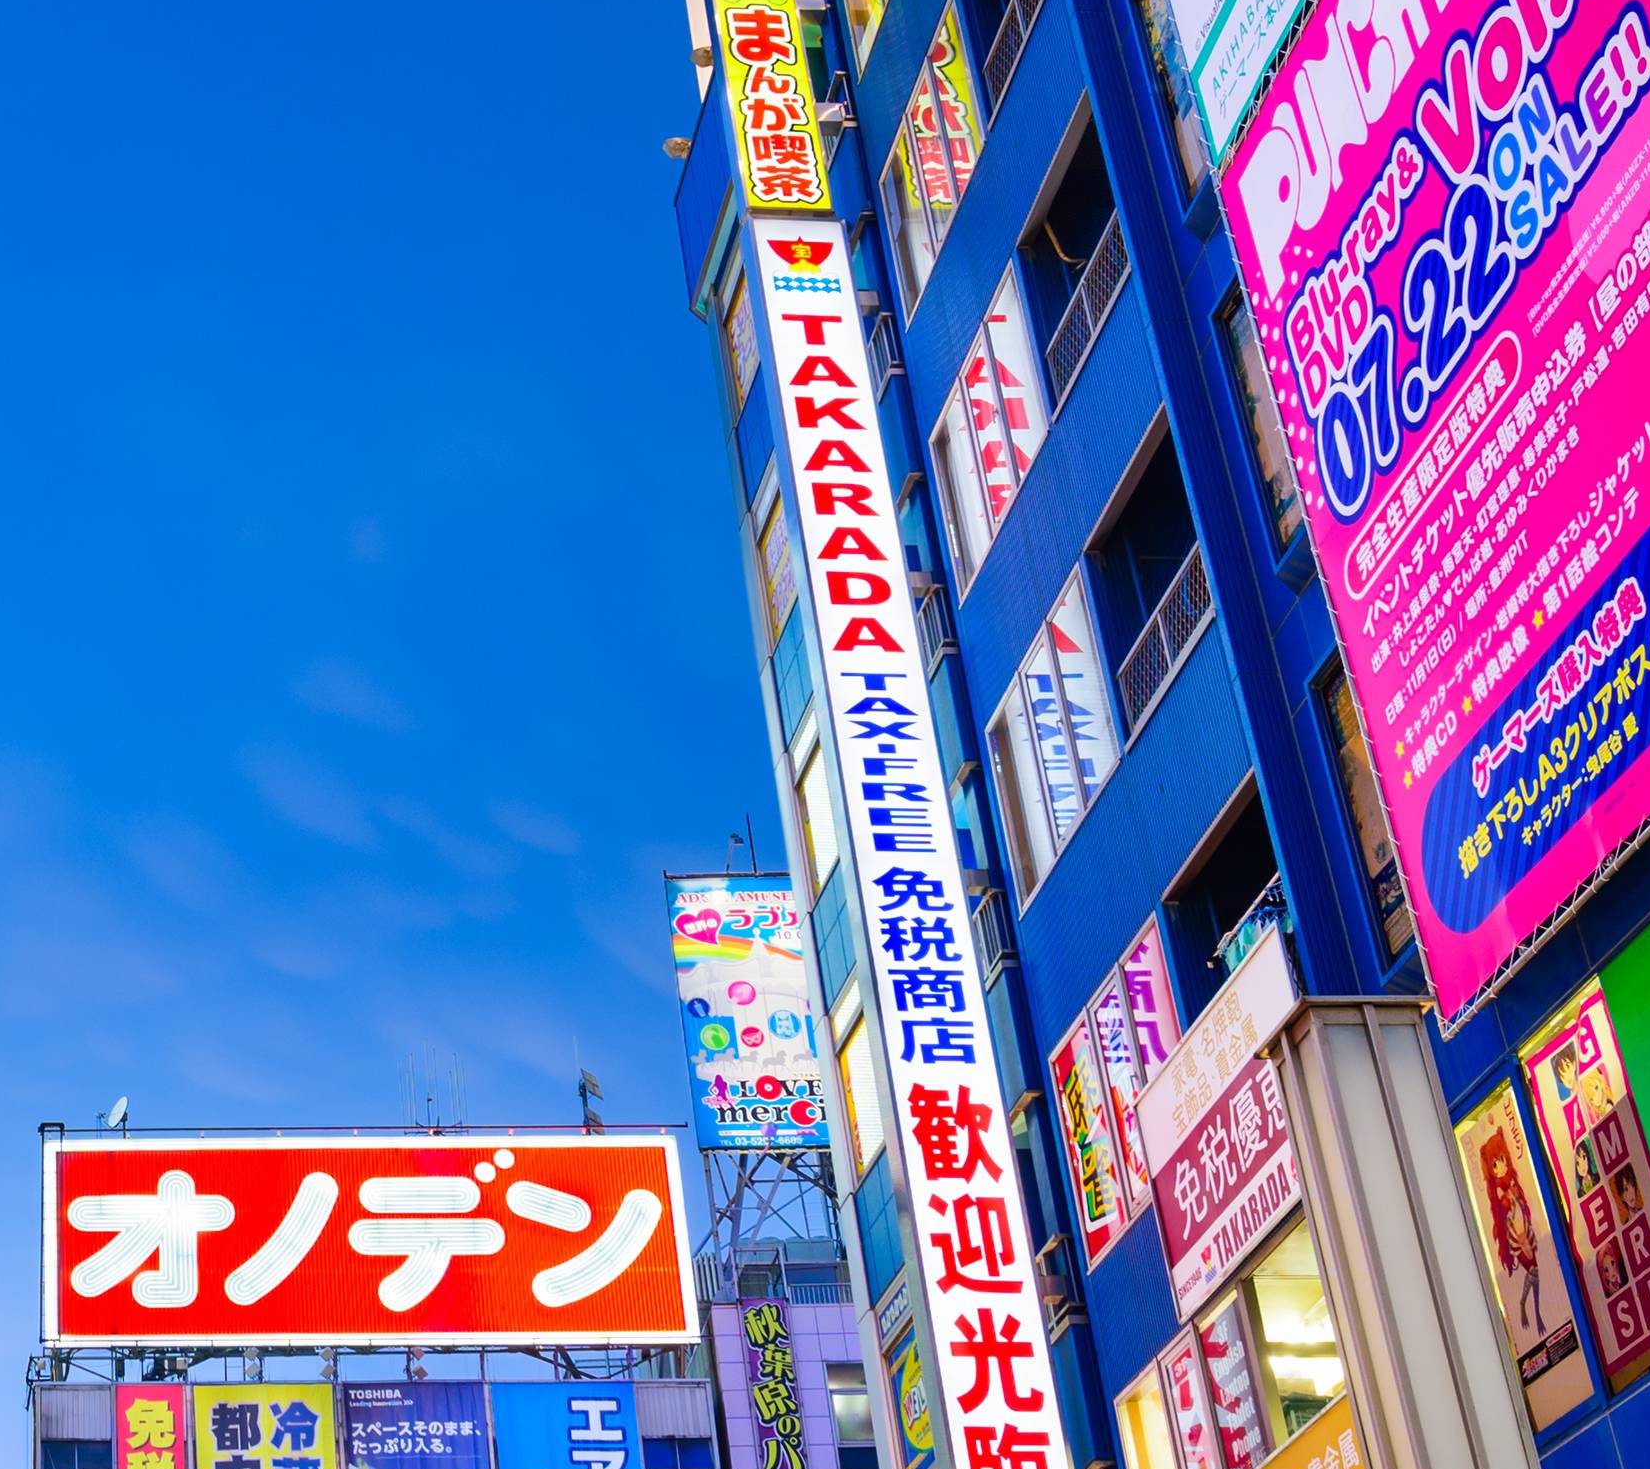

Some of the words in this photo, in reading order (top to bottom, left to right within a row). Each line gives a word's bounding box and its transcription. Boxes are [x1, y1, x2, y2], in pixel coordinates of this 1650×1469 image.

[724, 5, 821, 204] まんが喫茶
[1495, 87, 1552, 186] ON
[1300, 280, 1373, 407] DVD
[781, 312, 908, 656] TAKARADA
[1470, 574, 1645, 799] ゲーマーズ購入特典
[66, 1148, 664, 1311] オノデン
[1210, 1160, 1294, 1273] TAKARADA
[349, 1389, 402, 1399] TOSHIBA
[351, 1420, 484, 1437] スペースそのまま、
[352, 1437, 459, 1455] たっぷり入る。
